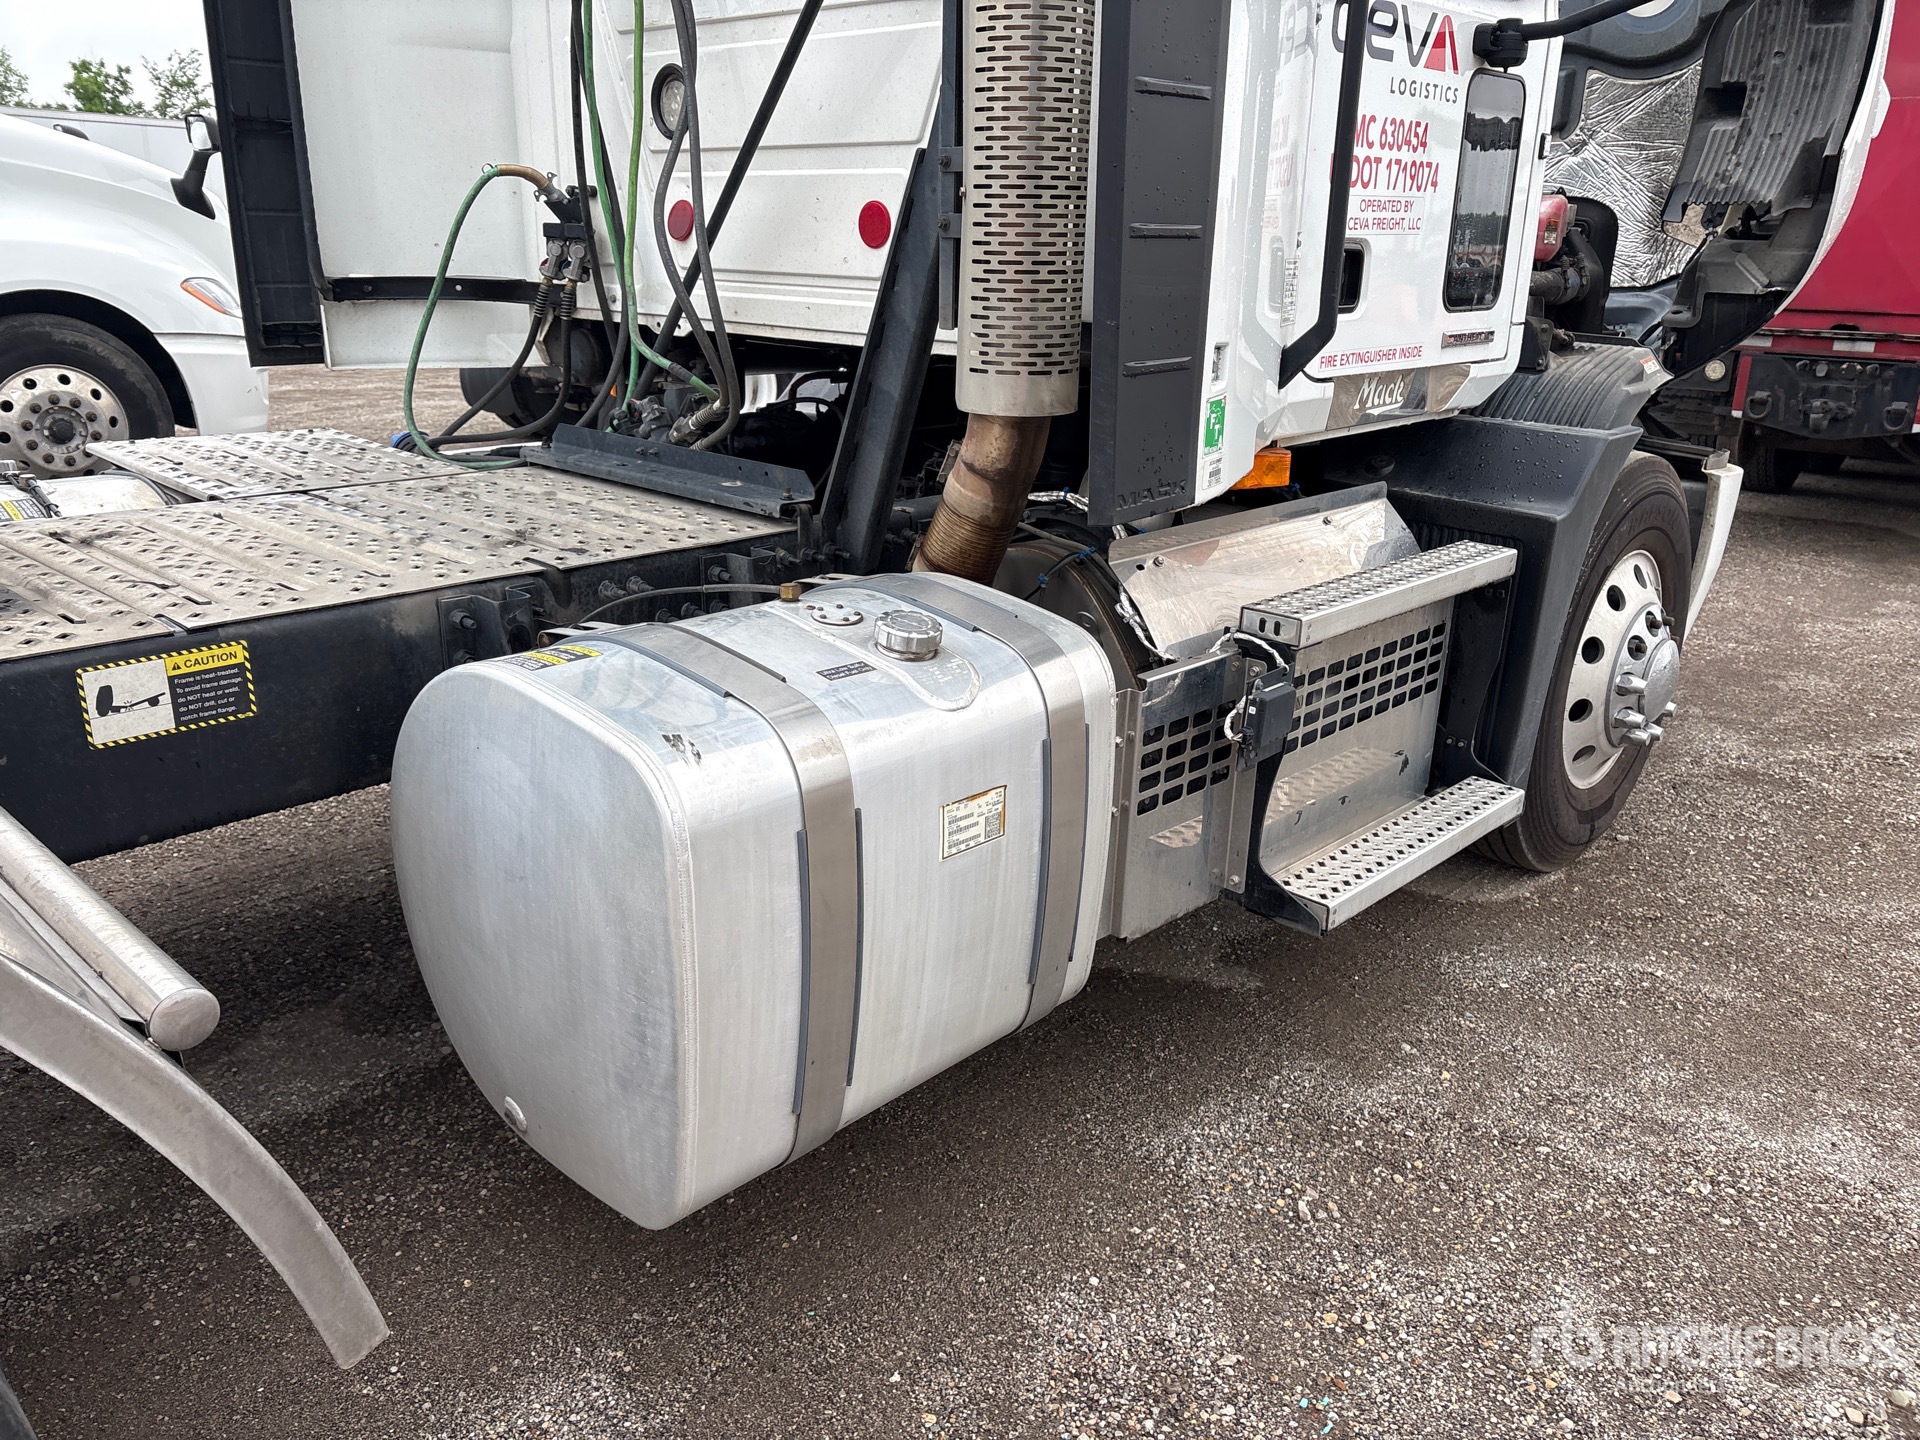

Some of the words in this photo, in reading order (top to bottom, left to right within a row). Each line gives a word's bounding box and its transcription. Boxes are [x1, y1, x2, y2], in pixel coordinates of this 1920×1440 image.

[1390, 77, 1459, 104] LOGISTICS
[1355, 114, 1376, 149] MC
[1380, 117, 1428, 154] 630454
[1386, 158, 1439, 193] 1719074
[1360, 199, 1402, 213] OPERATED
[1404, 200, 1414, 213] BY
[1348, 217, 1369, 230] CEVA
[1372, 218, 1406, 232] FREIGHT,
[1408, 218, 1421, 230] LLC
[1320, 355, 1338, 369] FIRE
[1340, 348, 1397, 366] EXTINGUISHER
[1398, 346, 1423, 360] INSIDE
[1353, 374, 1405, 410] Mack
[184, 651, 238, 668] CAUTION
[174, 676, 195, 685] Frame
[184, 684, 201, 692] avoid
[202, 680, 218, 689] frame
[187, 693, 201, 702] NOT
[188, 703, 203, 711] NOT
[180, 713, 199, 721] notch
[199, 709, 217, 718] frame
